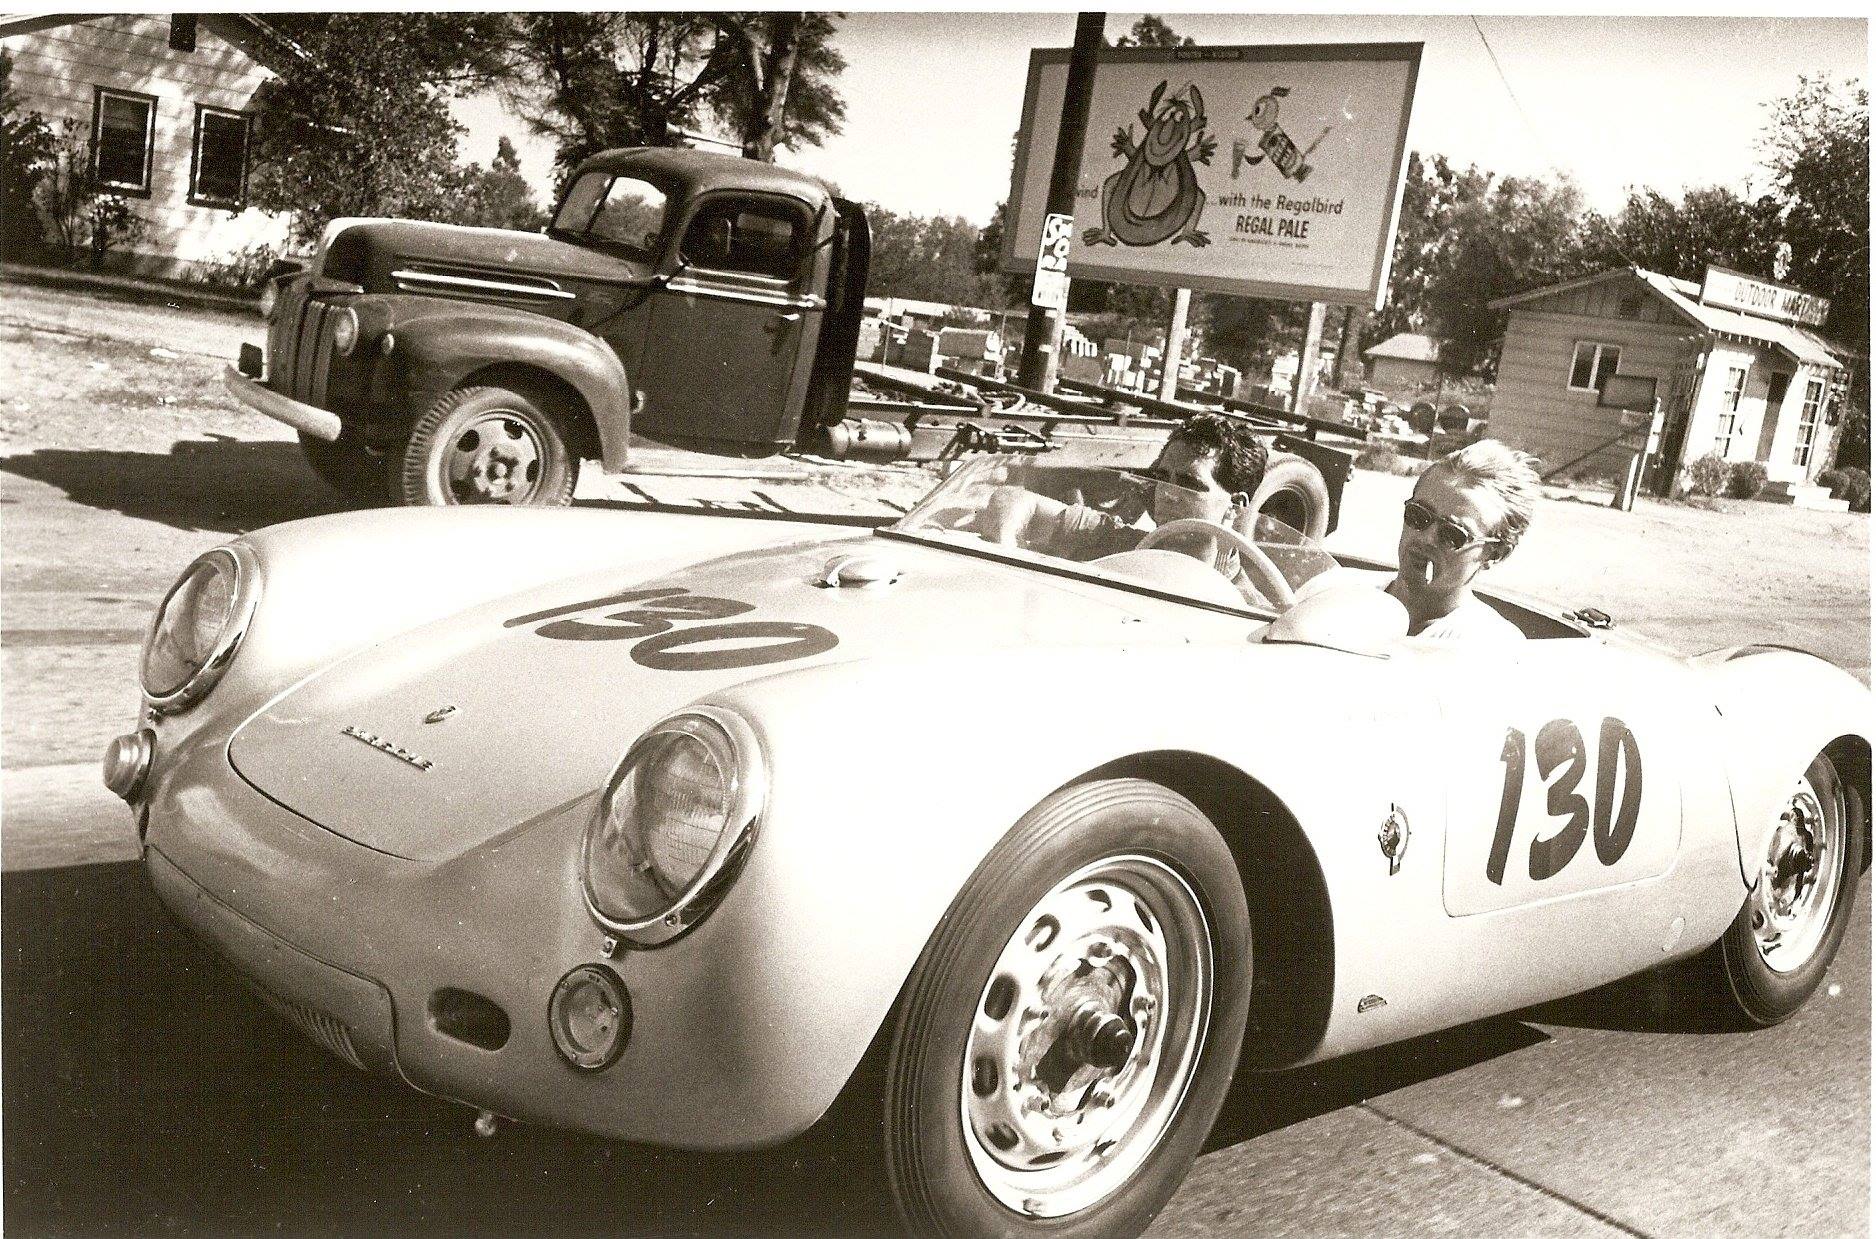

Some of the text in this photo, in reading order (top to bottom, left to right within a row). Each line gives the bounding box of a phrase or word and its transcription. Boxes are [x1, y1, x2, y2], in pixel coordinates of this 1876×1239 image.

[1250, 194, 1272, 210] the
[1276, 195, 1344, 216] Regalbird
[1236, 215, 1310, 239] REGAL PALE
[1734, 281, 1778, 309] OUTDOOR
[503, 588, 839, 671] 130
[1486, 716, 1642, 886] 130
